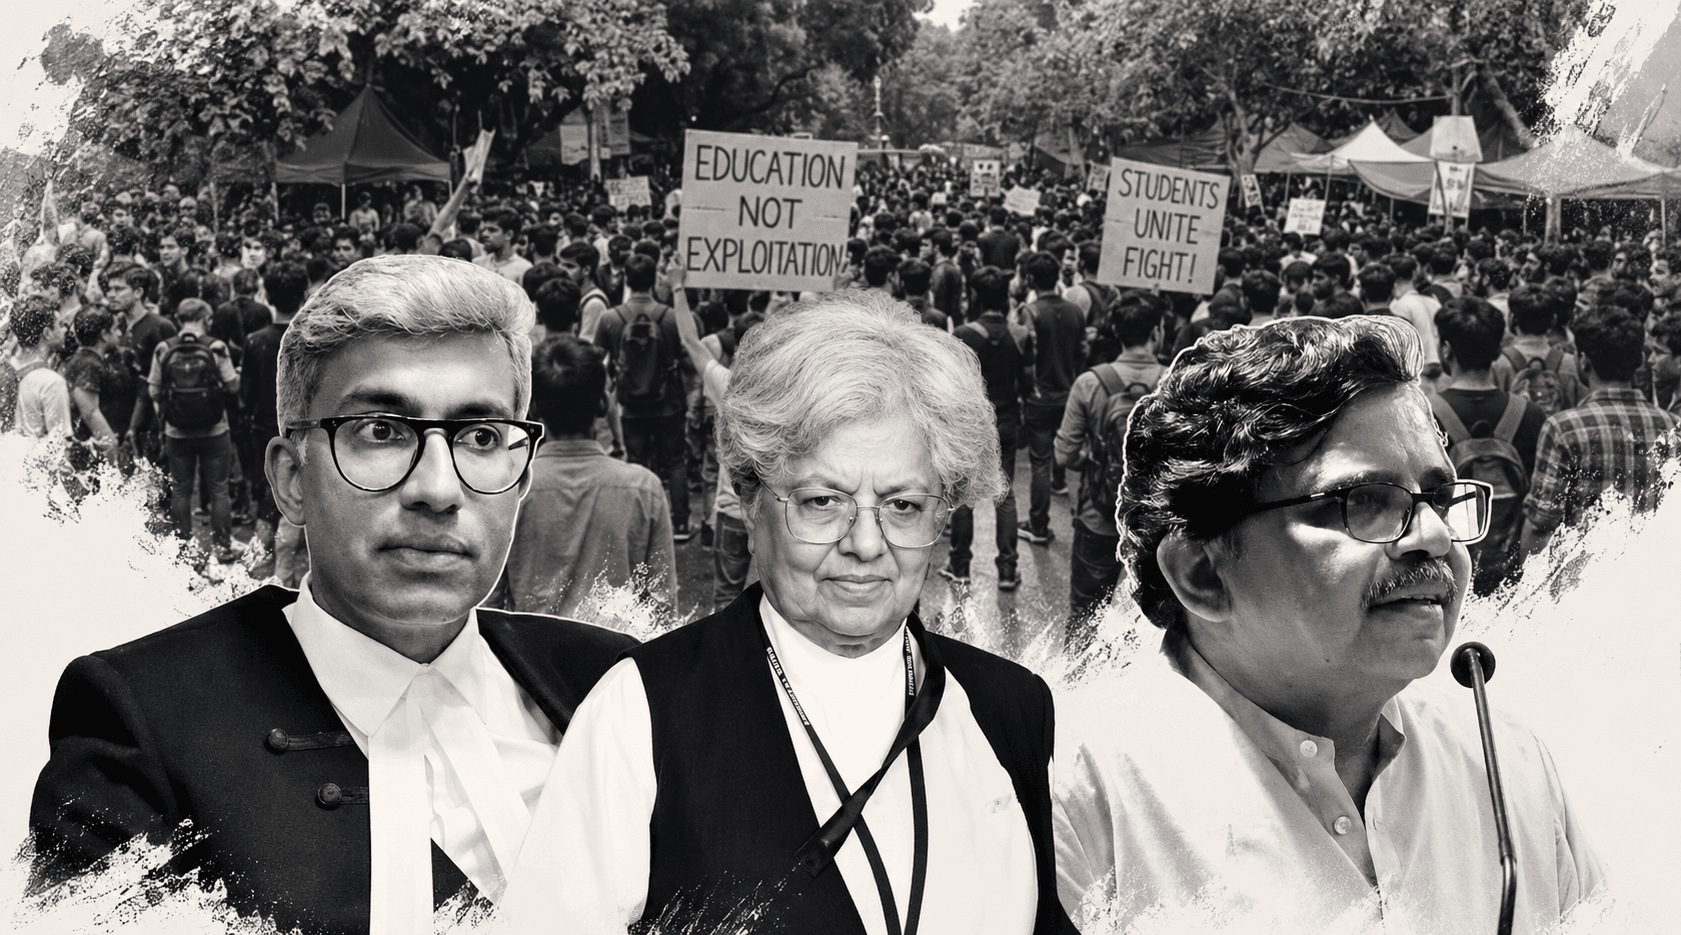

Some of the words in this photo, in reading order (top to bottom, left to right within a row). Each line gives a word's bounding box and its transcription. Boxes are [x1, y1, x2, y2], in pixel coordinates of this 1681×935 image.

[695, 144, 845, 189] EDUCATION
[1118, 168, 1220, 210] STUDENTS
[739, 195, 803, 229] NOT
[1134, 208, 1201, 245] UNITE
[686, 236, 844, 277] EXPLOITATION
[1122, 246, 1197, 284] FIGHT!
